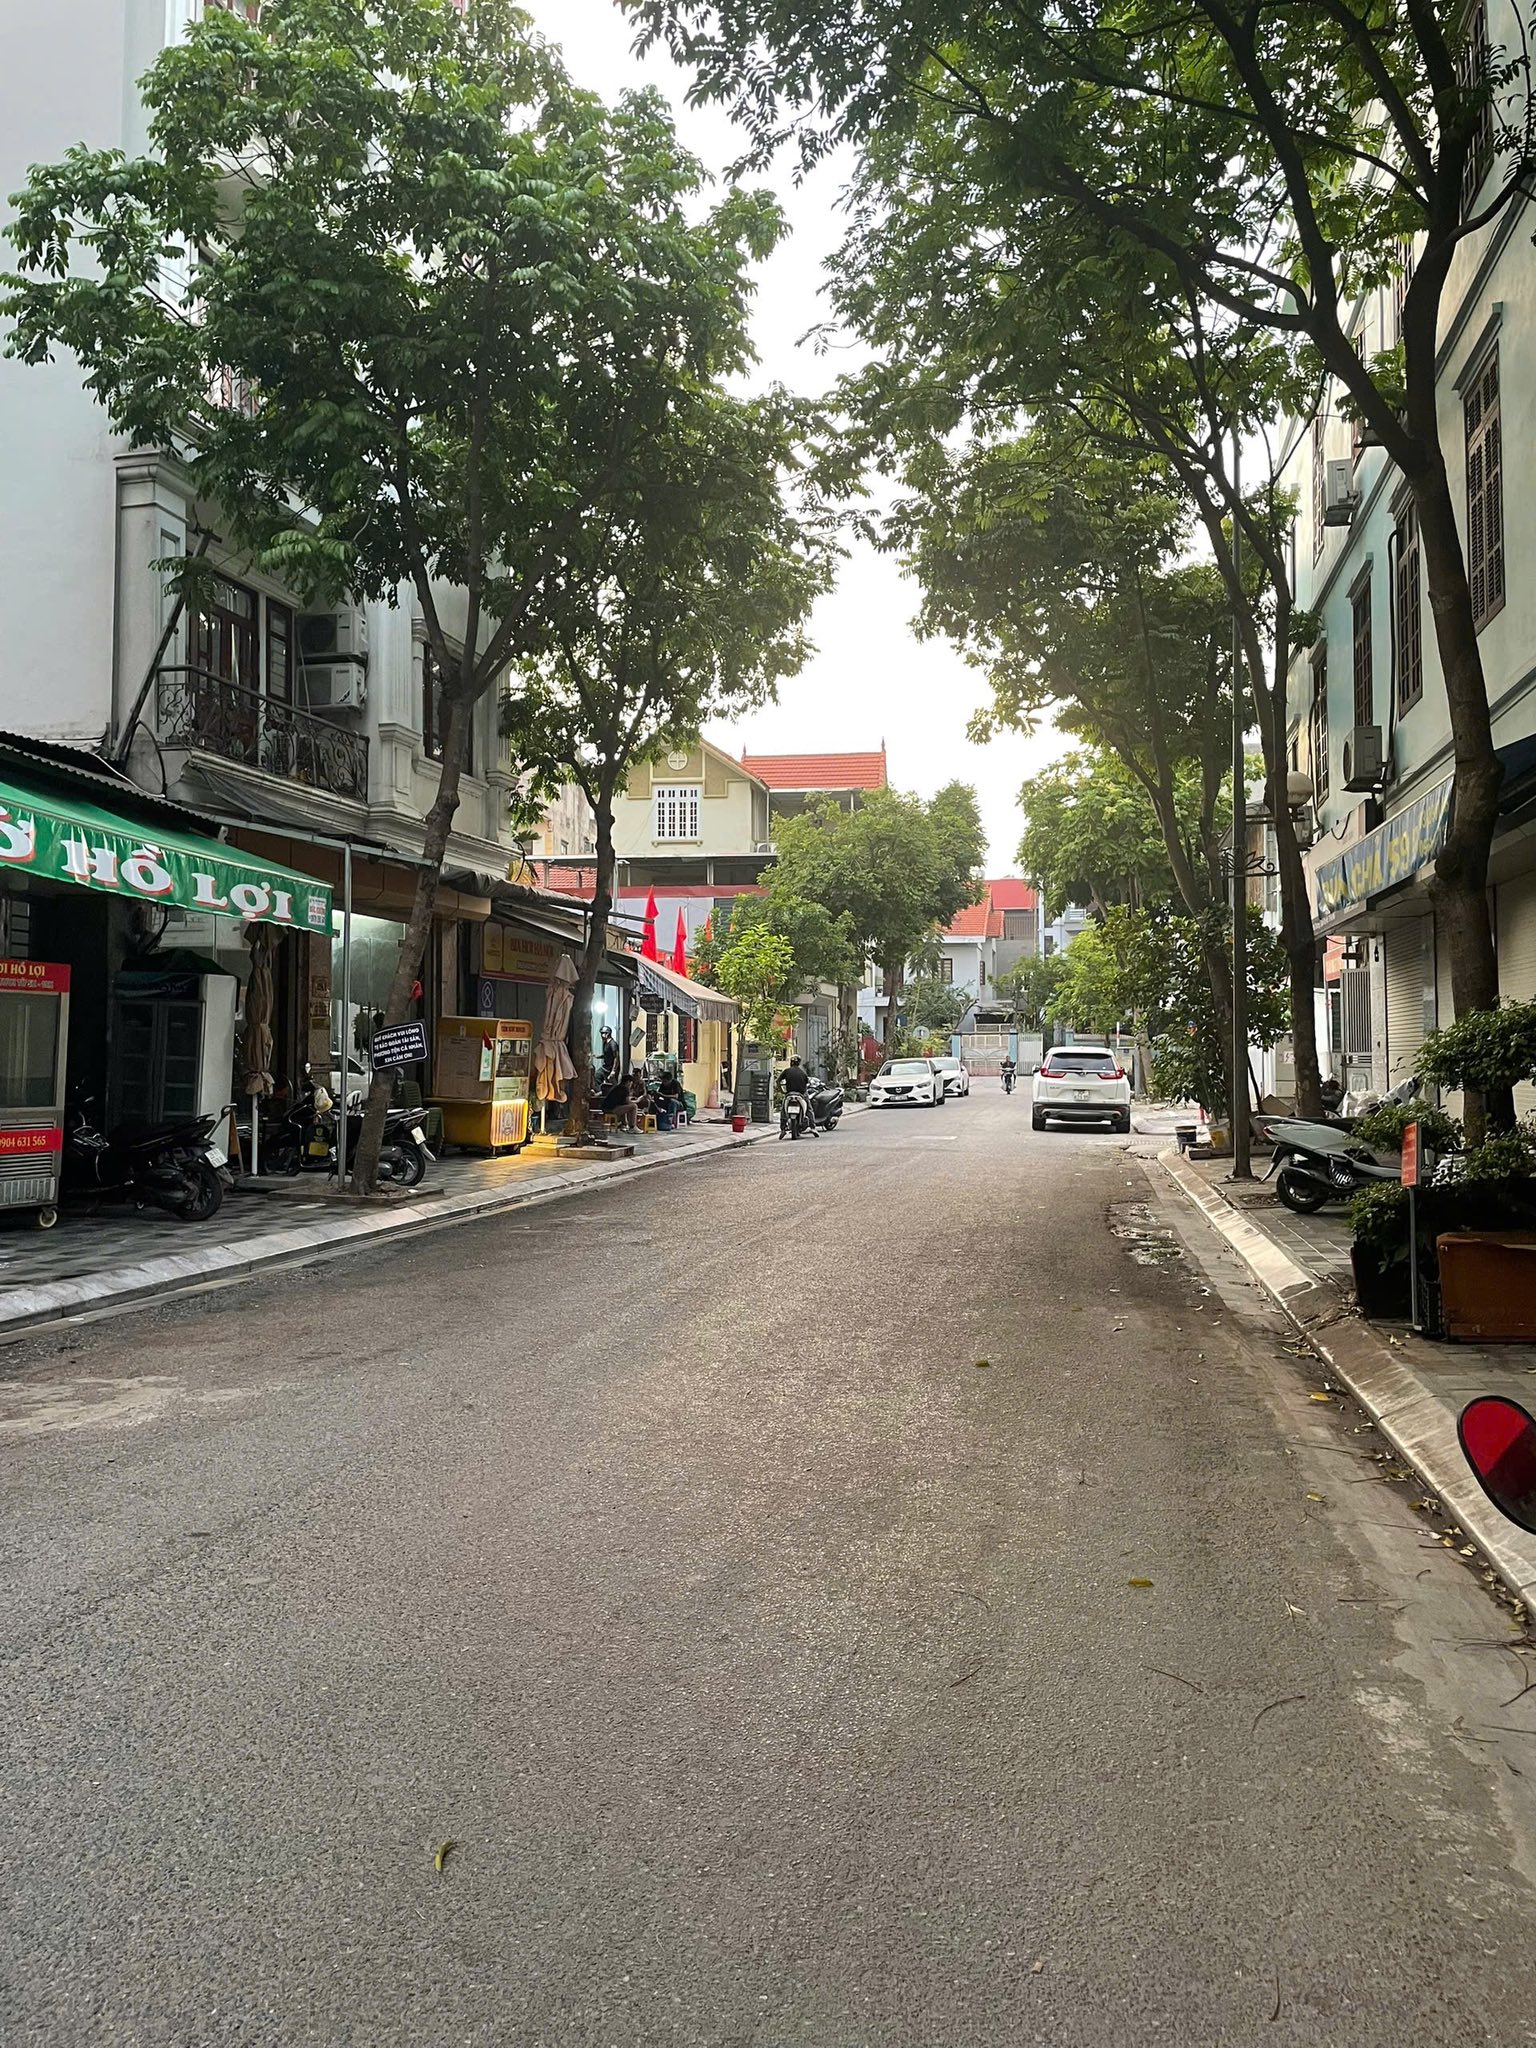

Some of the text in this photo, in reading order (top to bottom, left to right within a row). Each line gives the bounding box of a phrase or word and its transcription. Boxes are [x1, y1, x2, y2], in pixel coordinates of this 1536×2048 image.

[59, 840, 173, 895] HỒ
[191, 872, 293, 921] LỢI
[0, 1135, 47, 1148] 904 631 565
